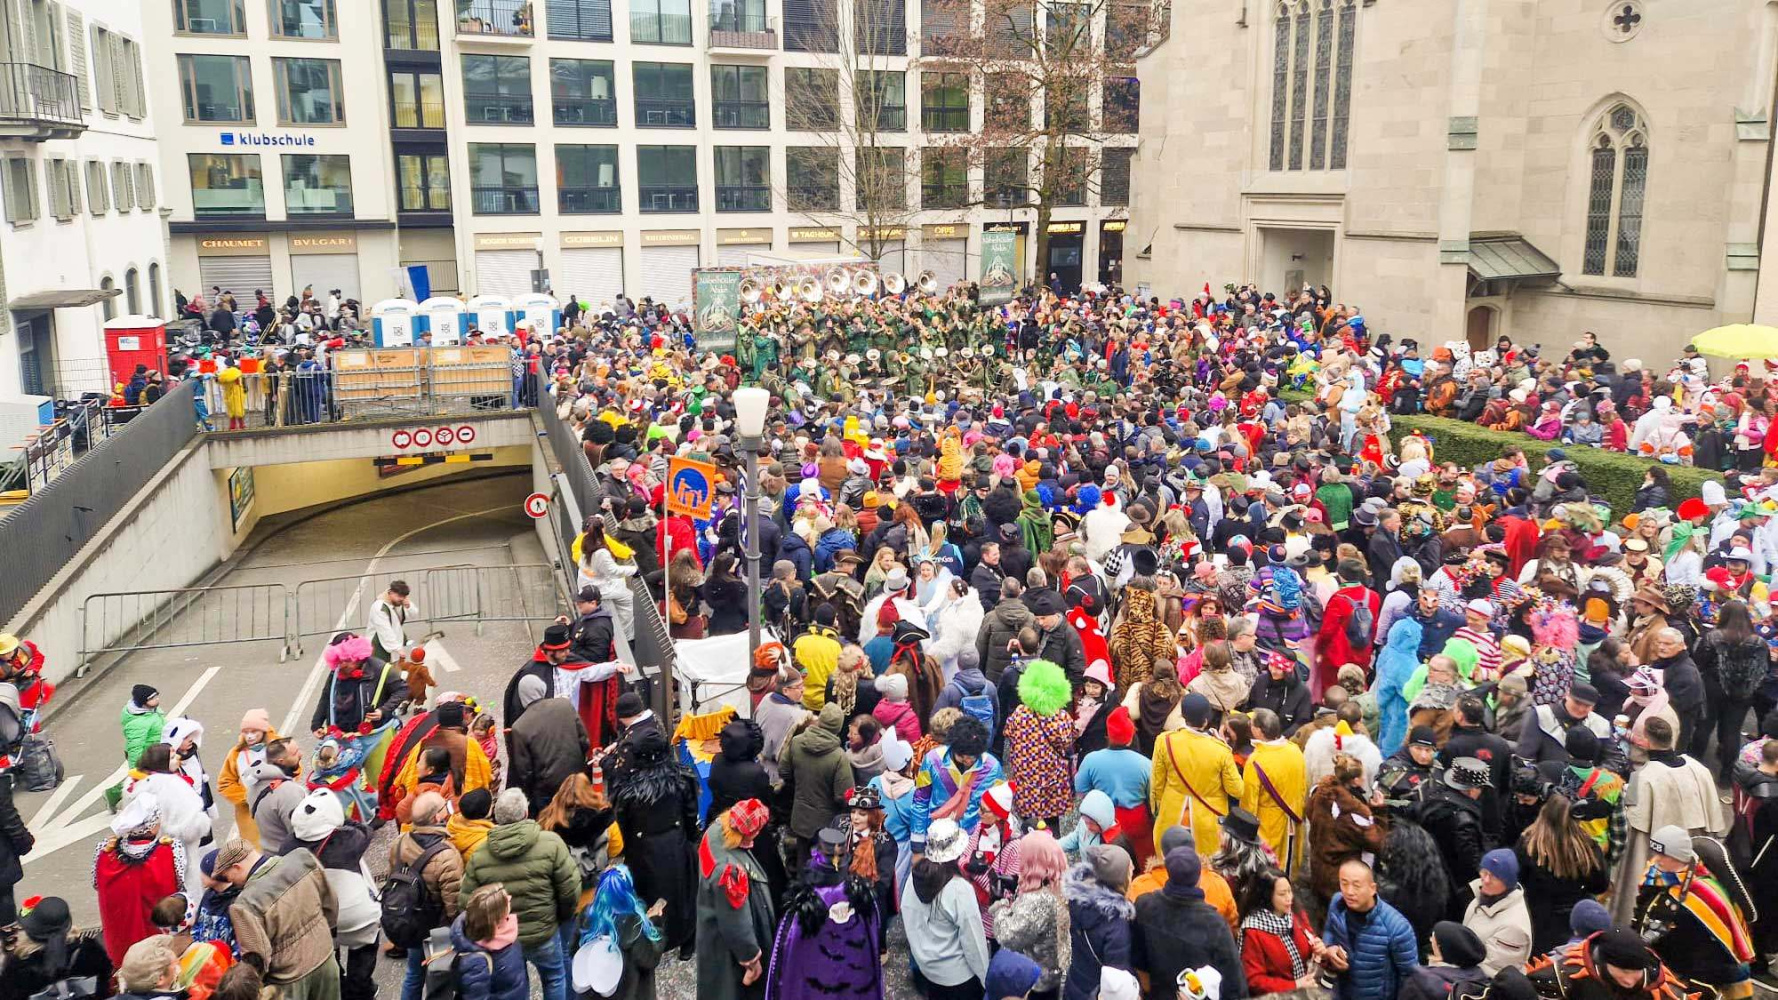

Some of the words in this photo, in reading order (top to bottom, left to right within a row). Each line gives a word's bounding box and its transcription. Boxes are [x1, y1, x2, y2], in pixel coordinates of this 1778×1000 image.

[239, 133, 315, 146] klubschule
[202, 239, 264, 248] CHAUMET
[293, 238, 352, 246] BVLGARI
